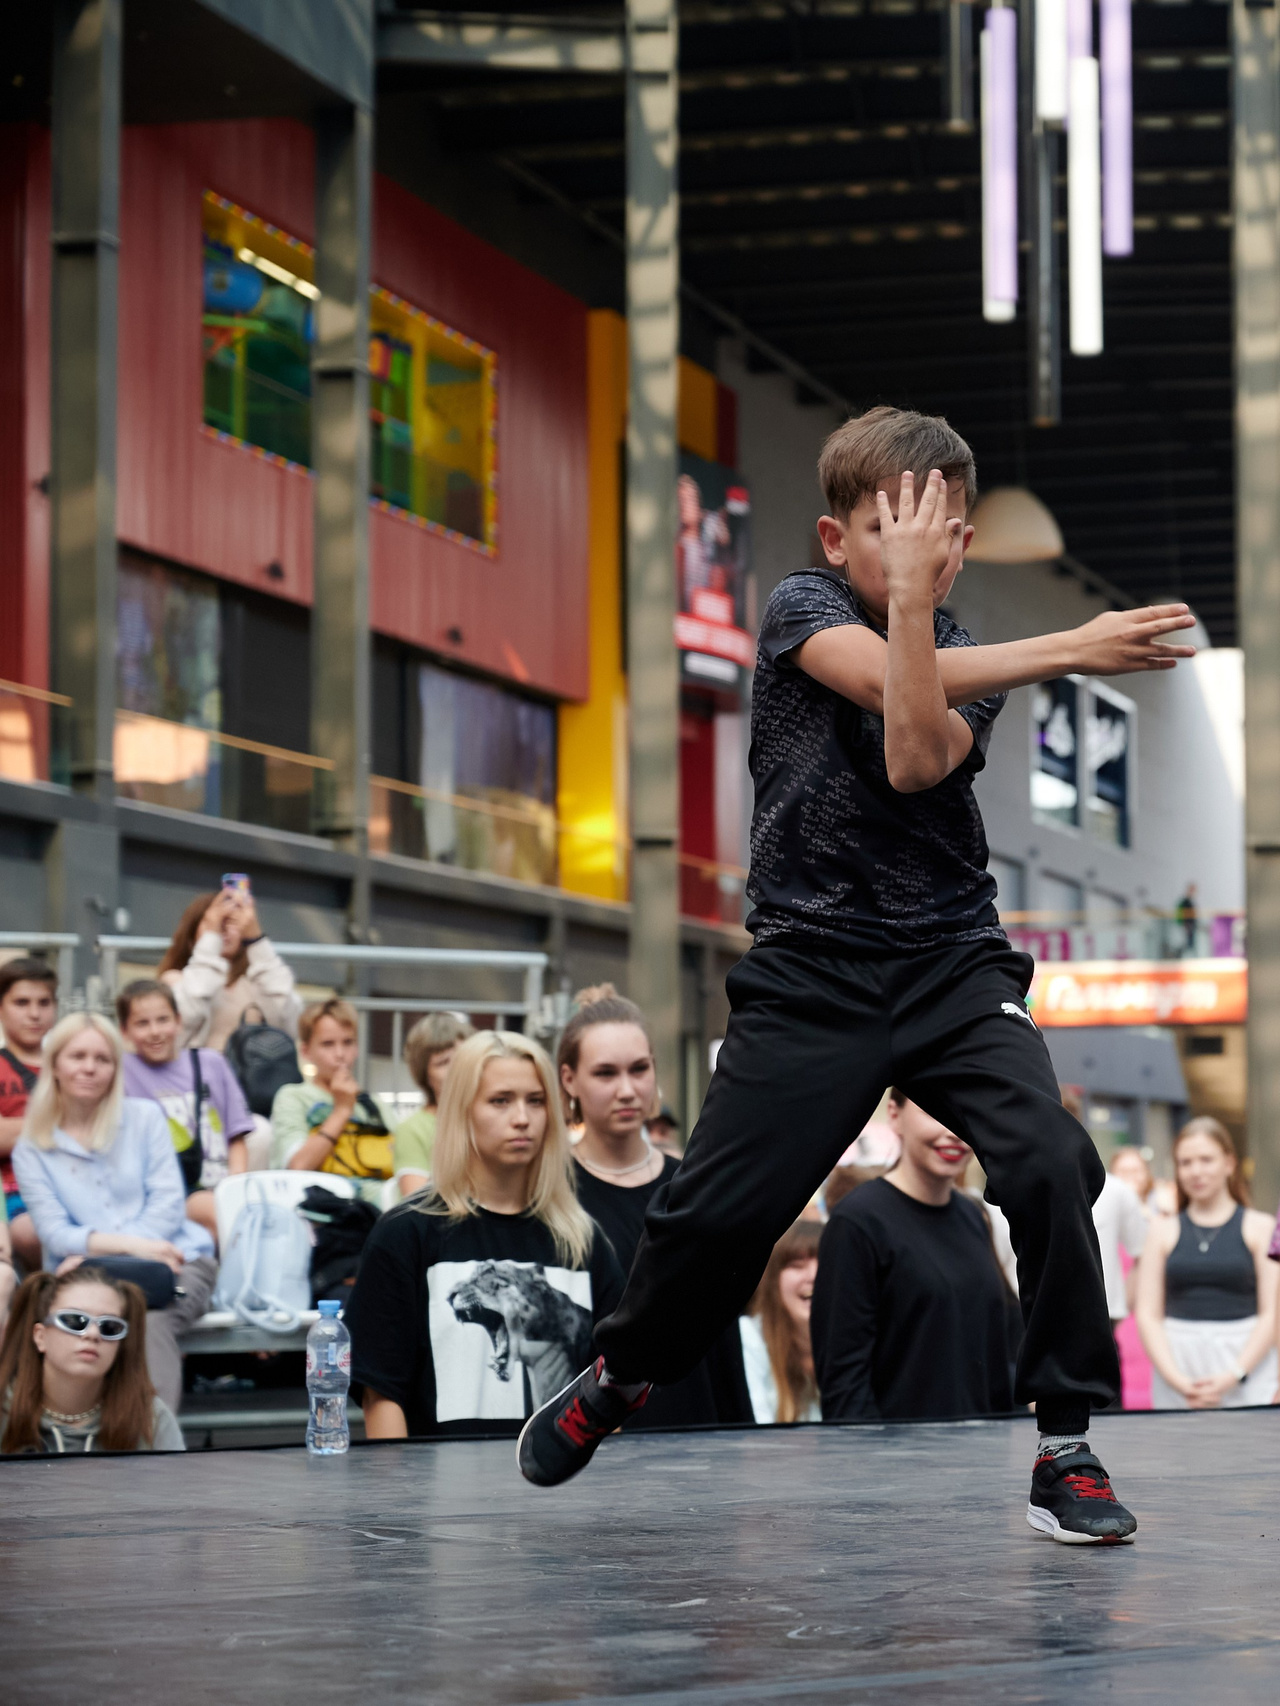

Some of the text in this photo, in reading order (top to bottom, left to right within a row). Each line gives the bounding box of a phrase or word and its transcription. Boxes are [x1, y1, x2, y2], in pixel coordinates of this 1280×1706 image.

[796, 730, 808, 738] FILA
[782, 735, 794, 743] FILA
[791, 746, 801, 754] FILA
[840, 771, 856, 780] FILA
[826, 778, 840, 787] FILA
[835, 776, 850, 786] FILA
[804, 785, 816, 794] FILA
[835, 788, 850, 797] FILA
[816, 793, 829, 802] FILA
[826, 790, 840, 800] FILA
[806, 802, 820, 810] FILA
[841, 798, 856, 808] FILA
[822, 804, 834, 814] FILA
[846, 806, 862, 815] FILA
[804, 814, 819, 822] FILA
[817, 811, 829, 820] FILA
[836, 810, 850, 819] FILA
[811, 838, 826, 846] FILA
[845, 840, 860, 848] FILA
[822, 846, 837, 854] FILA
[771, 851, 785, 859] FILA
[802, 856, 816, 864] FILA
[768, 873, 781, 881] FILA
